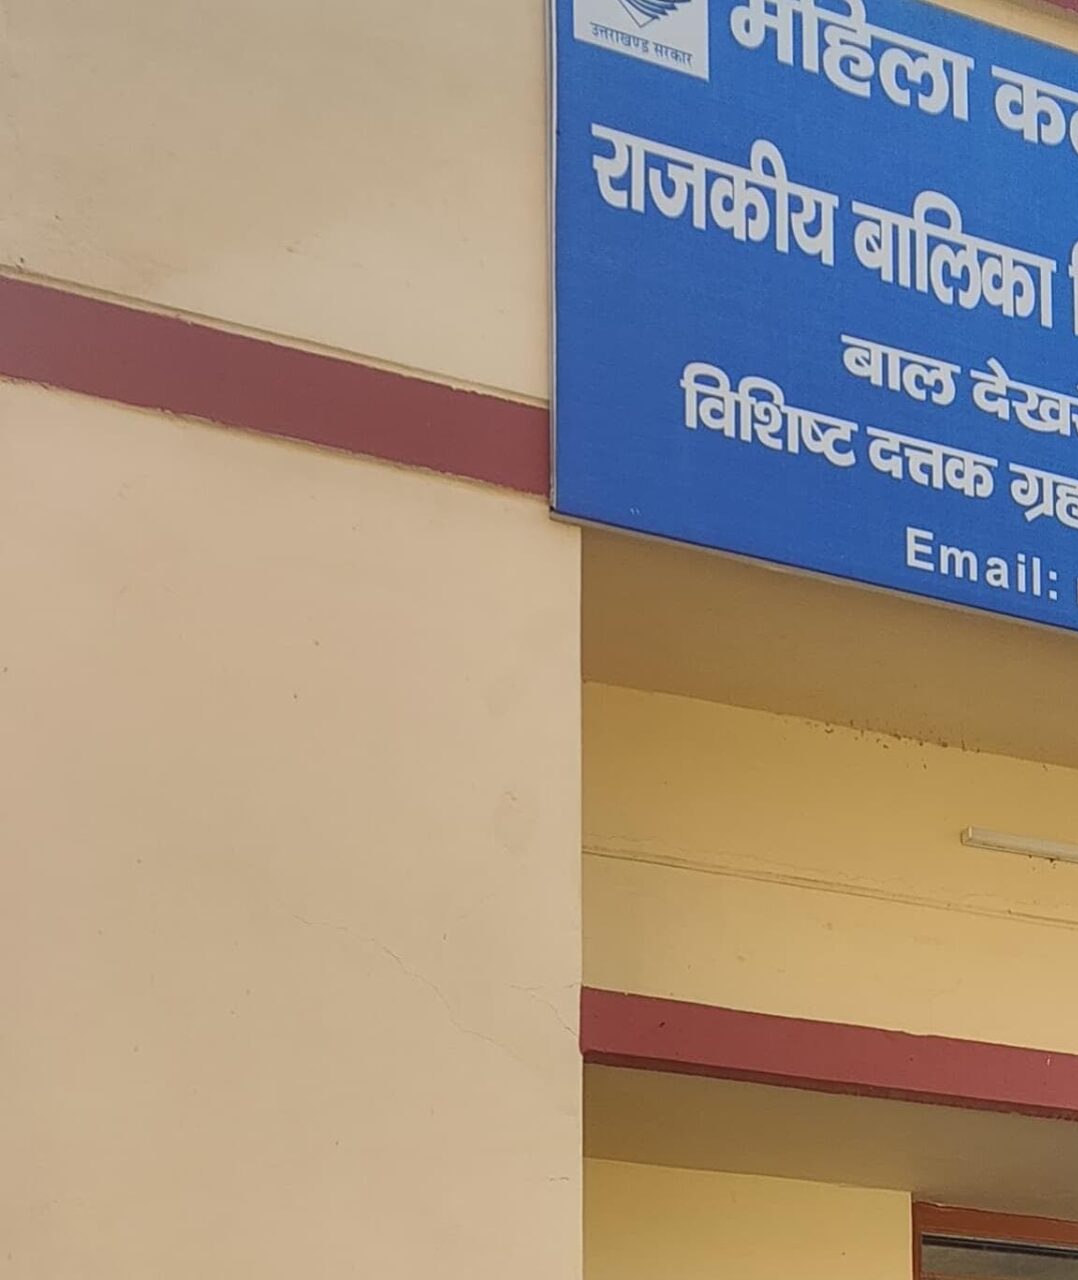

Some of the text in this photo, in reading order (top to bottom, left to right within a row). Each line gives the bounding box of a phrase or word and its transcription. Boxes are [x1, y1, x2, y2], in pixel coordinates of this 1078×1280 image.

[652, 42, 693, 67] सरकार
[730, 0, 974, 122] महिला
[591, 123, 839, 267] राजकीय
[852, 190, 1057, 329] बालिका
[840, 334, 961, 407] बाल
[680, 361, 858, 467] विशिष्ट
[867, 427, 998, 499] दत्तक
[905, 526, 1059, 601] Email:
